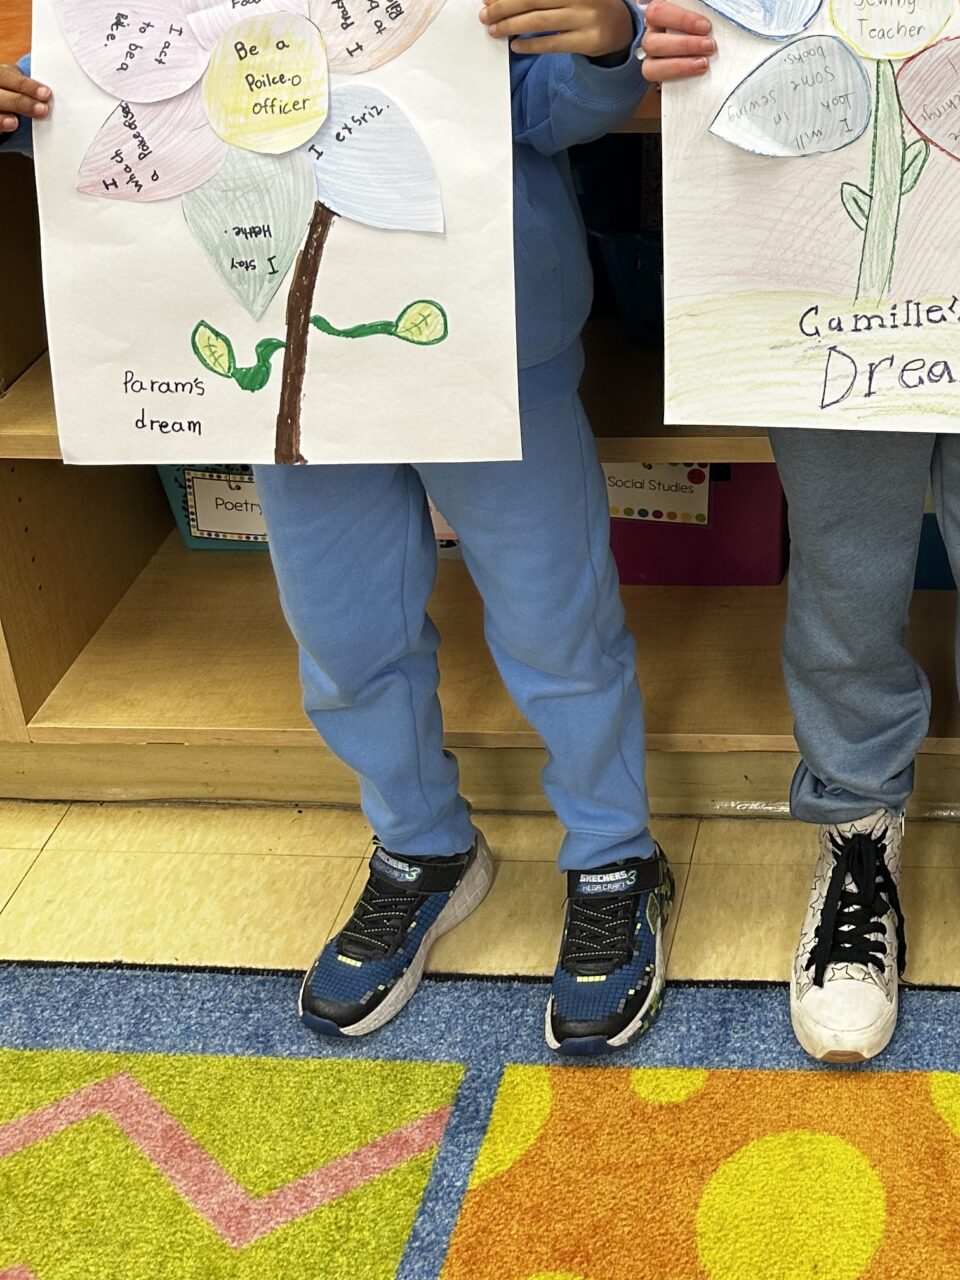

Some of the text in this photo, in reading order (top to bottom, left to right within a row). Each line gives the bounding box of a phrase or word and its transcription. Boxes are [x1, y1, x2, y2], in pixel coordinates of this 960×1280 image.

[373, 19, 387, 35] to
[857, 18, 926, 40] Teacher
[116, 21, 155, 72] to be a
[154, 23, 183, 65] I act
[234, 40, 290, 61] Be a
[346, 41, 363, 58] I
[252, 97, 310, 115] officer
[773, 94, 852, 126] look in
[795, 118, 853, 150] I will
[308, 144, 324, 160] I
[102, 178, 119, 191] I
[150, 170, 160, 182] a
[267, 255, 279, 275] I
[123, 370, 205, 396] Param's
[135, 408, 202, 435] dream
[607, 476, 694, 494] Social Studies
[579, 870, 628, 883] SKECHERS
[602, 882, 626, 891] CRAFT
